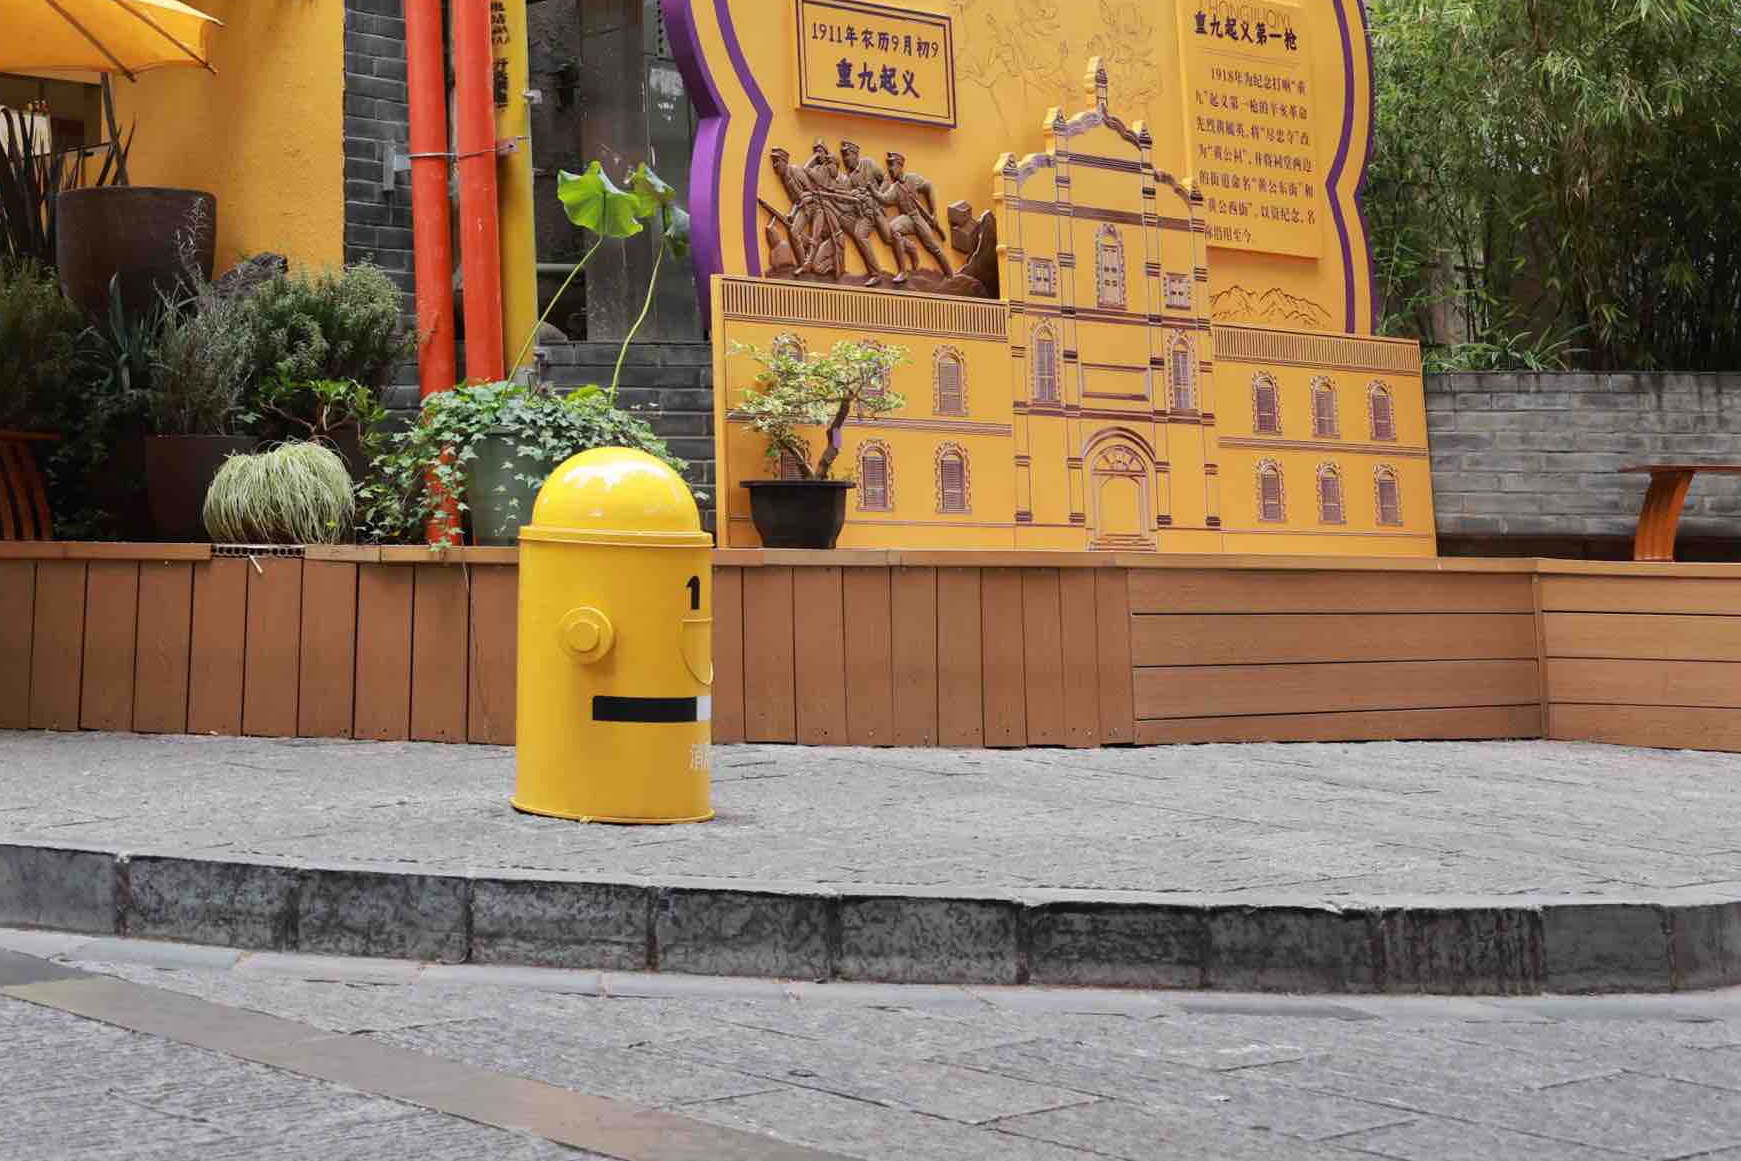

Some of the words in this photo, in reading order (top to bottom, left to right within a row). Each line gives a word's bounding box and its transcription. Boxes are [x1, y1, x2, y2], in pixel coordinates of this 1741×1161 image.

[812, 23, 939, 58] 1911年农历9月初9
[1194, 10, 1297, 50] 重九起义第一枪
[836, 57, 920, 98] 重九起义
[686, 575, 700, 610] 1
